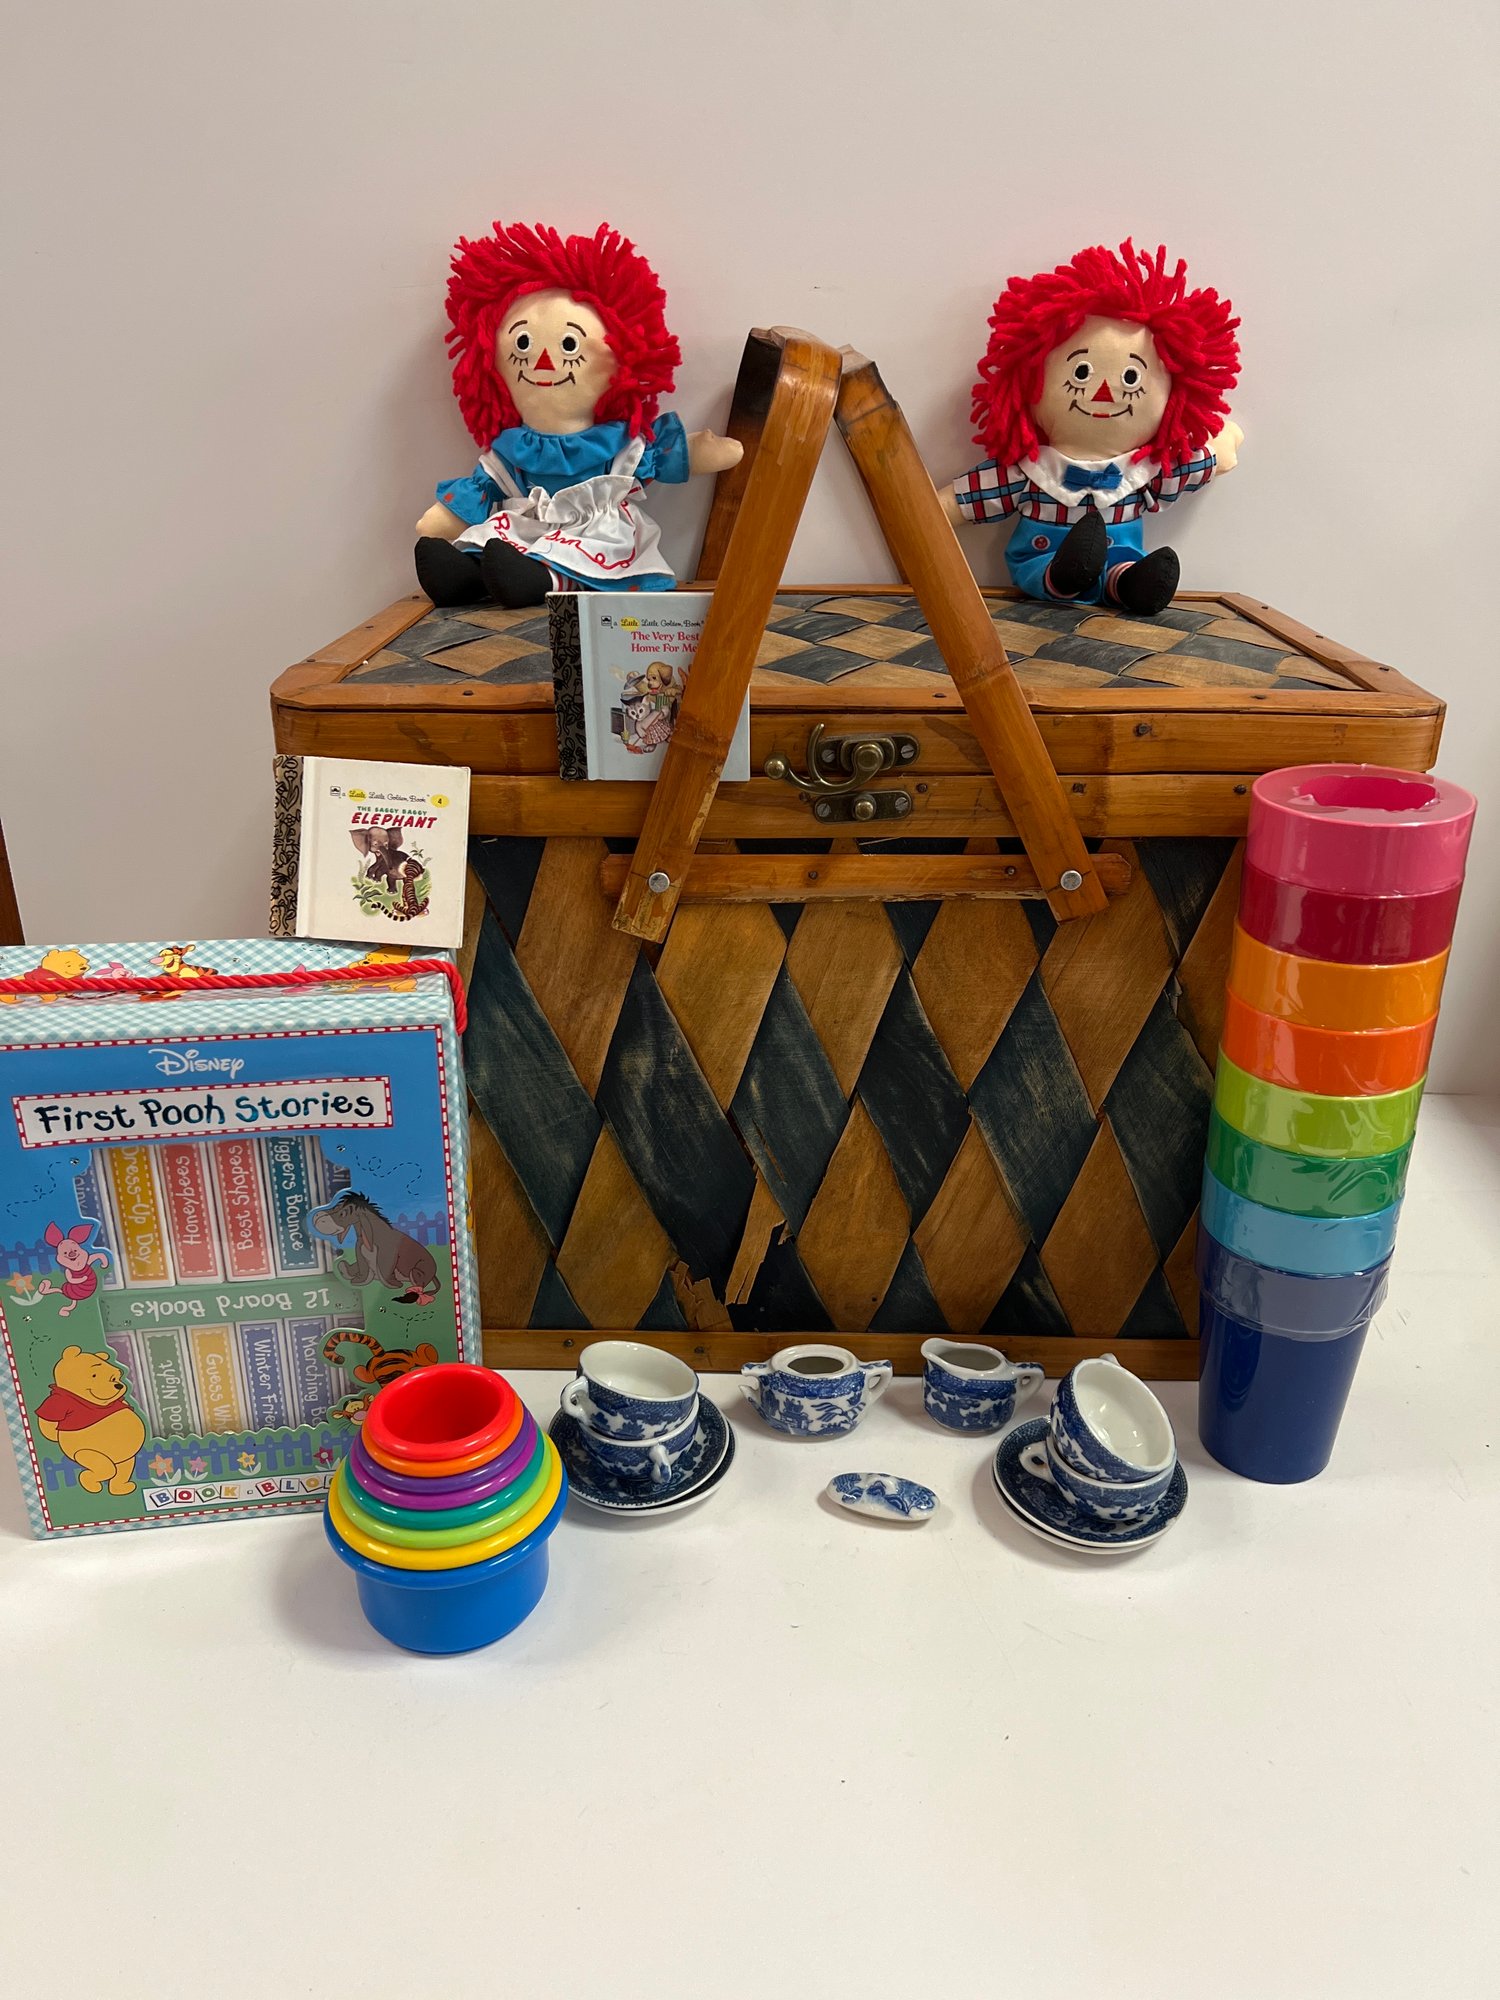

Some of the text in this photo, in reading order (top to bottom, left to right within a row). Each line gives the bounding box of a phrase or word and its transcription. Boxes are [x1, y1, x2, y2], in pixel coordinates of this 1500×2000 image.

[620, 618, 639, 627] Little
[641, 618, 658, 627] Little
[660, 619, 683, 628] Golden
[631, 631, 700, 642] The Very Best
[631, 643, 698, 653] Home For Me
[351, 811, 438, 829] ELEPHANT
[33, 1091, 375, 1133] First Pooh Stories
[175, 1155, 203, 1246] Honeybees
[227, 1145, 254, 1251] Best Shapes
[285, 1194, 305, 1252] Bounce
[135, 1232, 154, 1264] Day
[130, 1288, 331, 1323] 12 Board Books
[156, 1359, 181, 1400] Night
[206, 1353, 224, 1402] Guess
[253, 1339, 273, 1390] Winter
[301, 1335, 324, 1402] Marching
